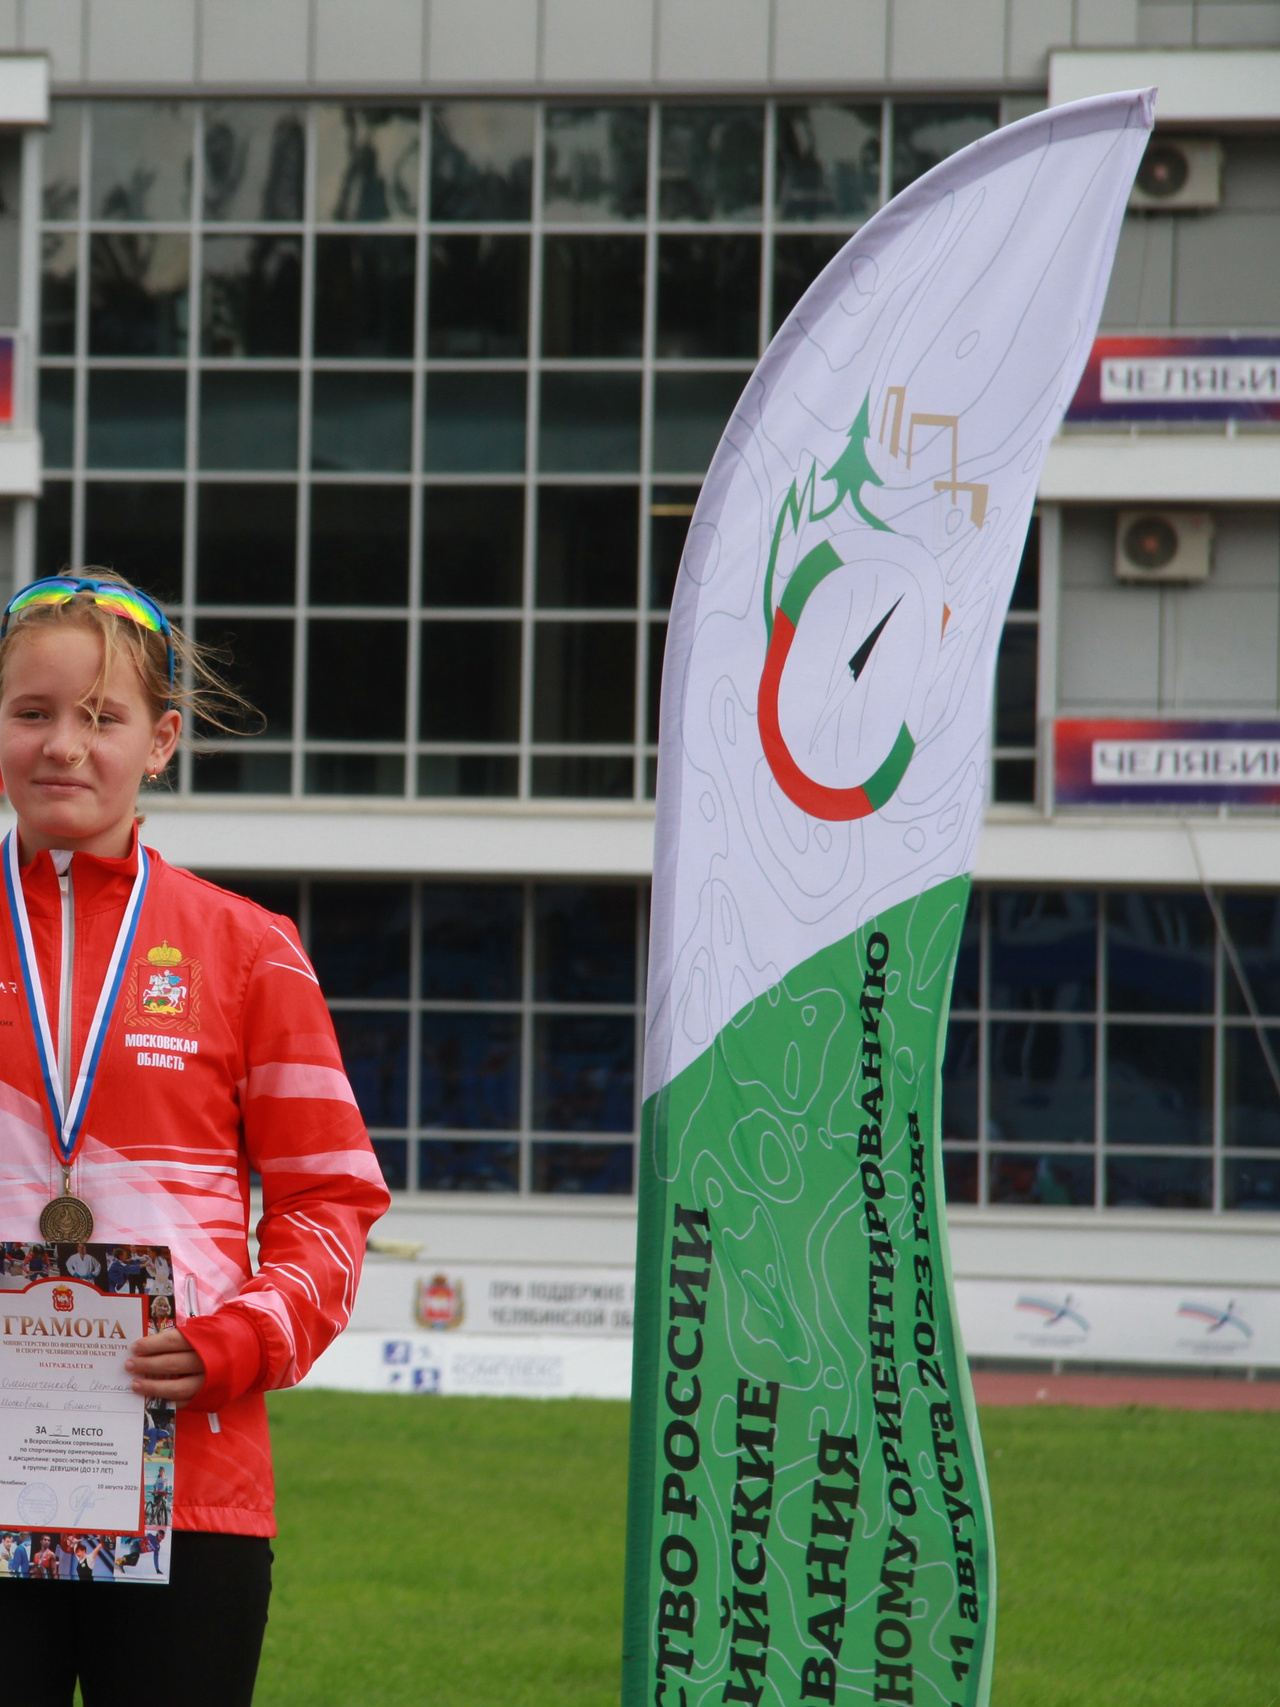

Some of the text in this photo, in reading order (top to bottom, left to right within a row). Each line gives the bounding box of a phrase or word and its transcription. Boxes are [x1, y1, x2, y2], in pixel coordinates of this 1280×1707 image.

[125, 1033, 198, 1054] МОСКОВСКАЯ
[137, 1052, 185, 1071] ОБЛАСТЬ
[857, 932, 917, 1516] ОРИЕНТИРОВАНИЮ
[3, 1315, 127, 1339] ГРАМОТА
[3, 1340, 50, 1348] МИНИСТЕРСТВО
[45, 1348, 88, 1357] ЧЕЛЯБИНСКОЙ
[39, 1361, 93, 1369] НАГРАЖДАЕТСЯ
[661, 1203, 712, 1521] РОССИИ
[908, 1111, 980, 1682] 11 августа 2023 года
[35, 1425, 47, 1434] ЗА
[71, 1427, 104, 1437] МЕСТО
[29, 1437, 71, 1446] Всероссийских
[28, 1447, 66, 1455] спортивному
[68, 1449, 118, 1457] ориентированию
[13, 1455, 50, 1463] дисциплине:
[49, 1465, 79, 1473] ДЕВУШКИ
[80, 1466, 91, 1474] (ДО
[100, 1467, 113, 1475] ЛЕТ)
